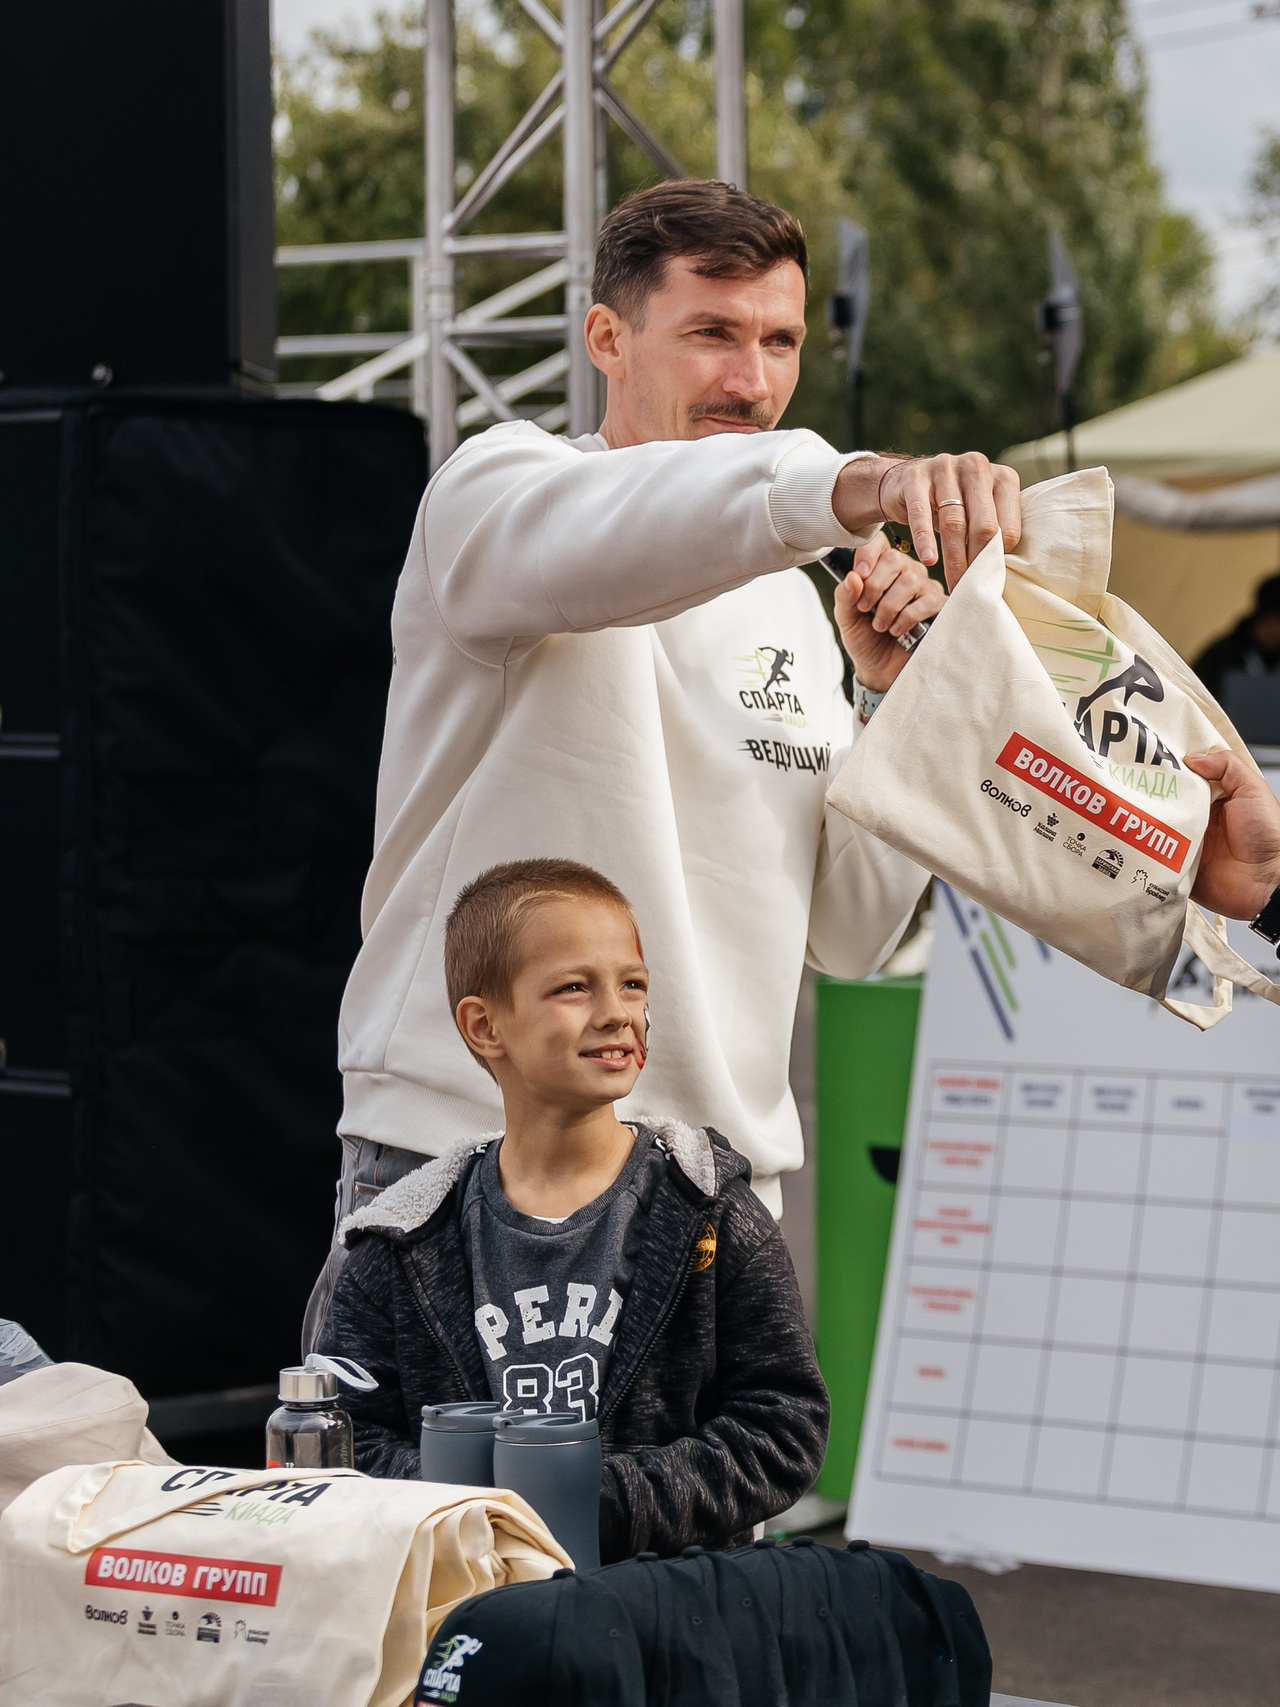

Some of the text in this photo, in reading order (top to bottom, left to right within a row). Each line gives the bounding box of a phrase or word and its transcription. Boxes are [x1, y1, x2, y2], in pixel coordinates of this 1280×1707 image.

[739, 690, 804, 715] СПАРТА
[1062, 702, 1181, 771] АРТА
[746, 738, 831, 775] ВЕДУЩИЙ
[1108, 763, 1179, 801] КИАДА
[1013, 747, 1179, 860] ВОЛКОВ ГРУПП
[1062, 841, 1083, 857] СБОРА
[1067, 835, 1087, 852] ТОЧКА
[503, 1353, 600, 1422] 83
[161, 1468, 333, 1507] СПРТА
[224, 1501, 298, 1525] КИАДА
[97, 1554, 268, 1596] ВОЛКОВ ГРУПП
[422, 1667, 461, 1693] СПАРТА
